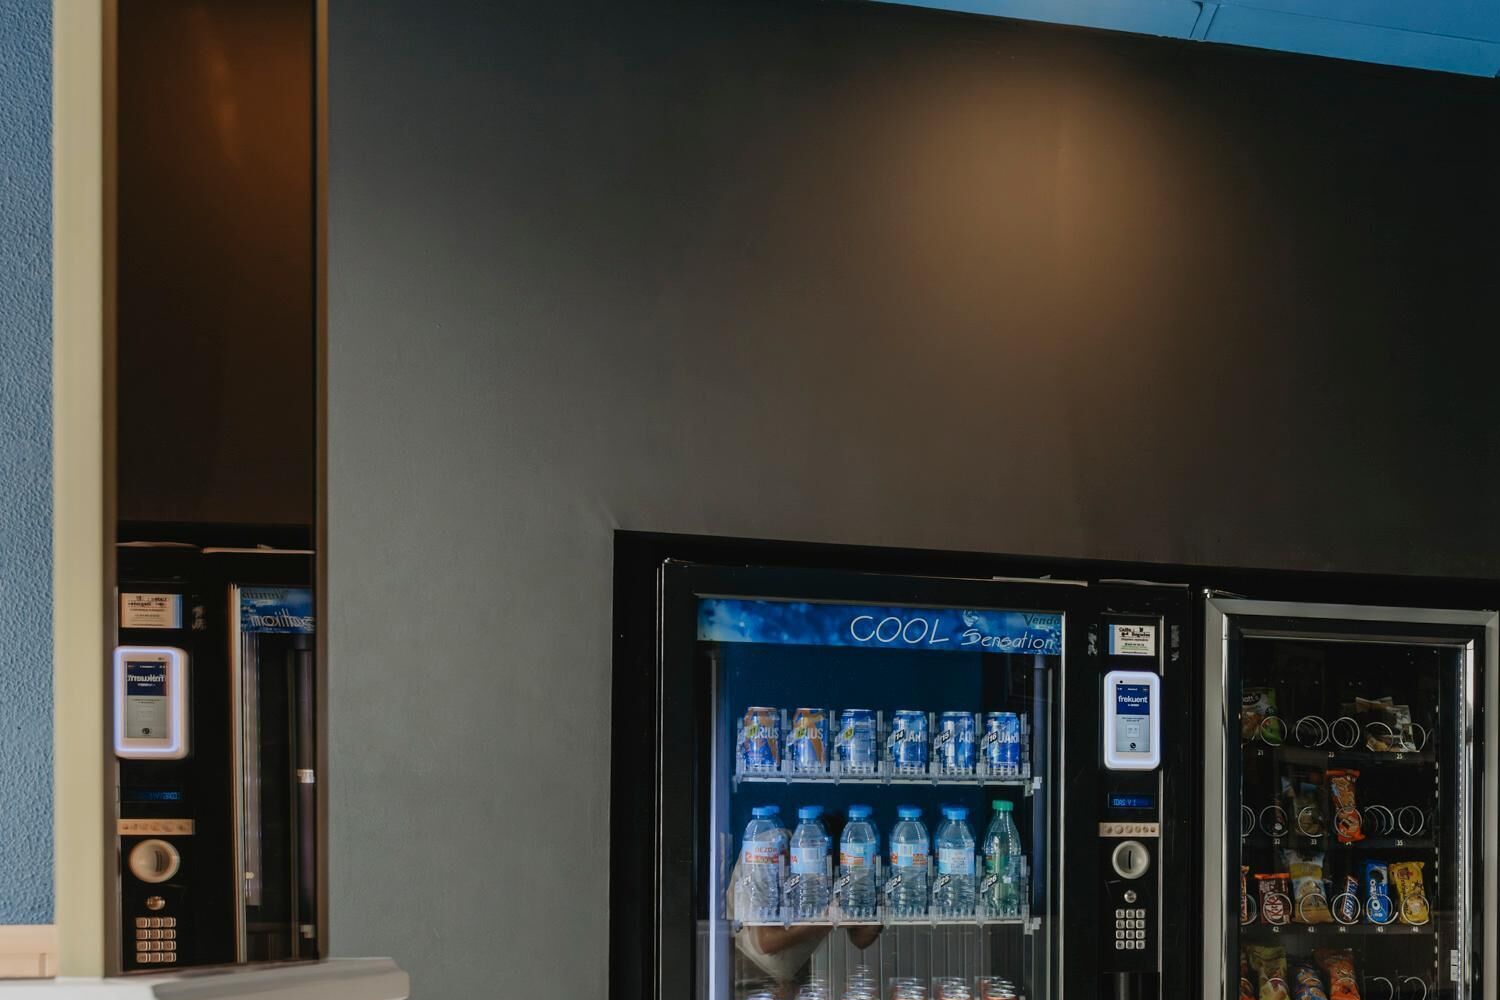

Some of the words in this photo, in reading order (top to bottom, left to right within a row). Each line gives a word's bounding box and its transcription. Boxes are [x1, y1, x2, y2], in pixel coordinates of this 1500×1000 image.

[850, 615, 949, 645] COOL
[960, 628, 1055, 650] Sensation
[1118, 695, 1148, 703] frekuent
